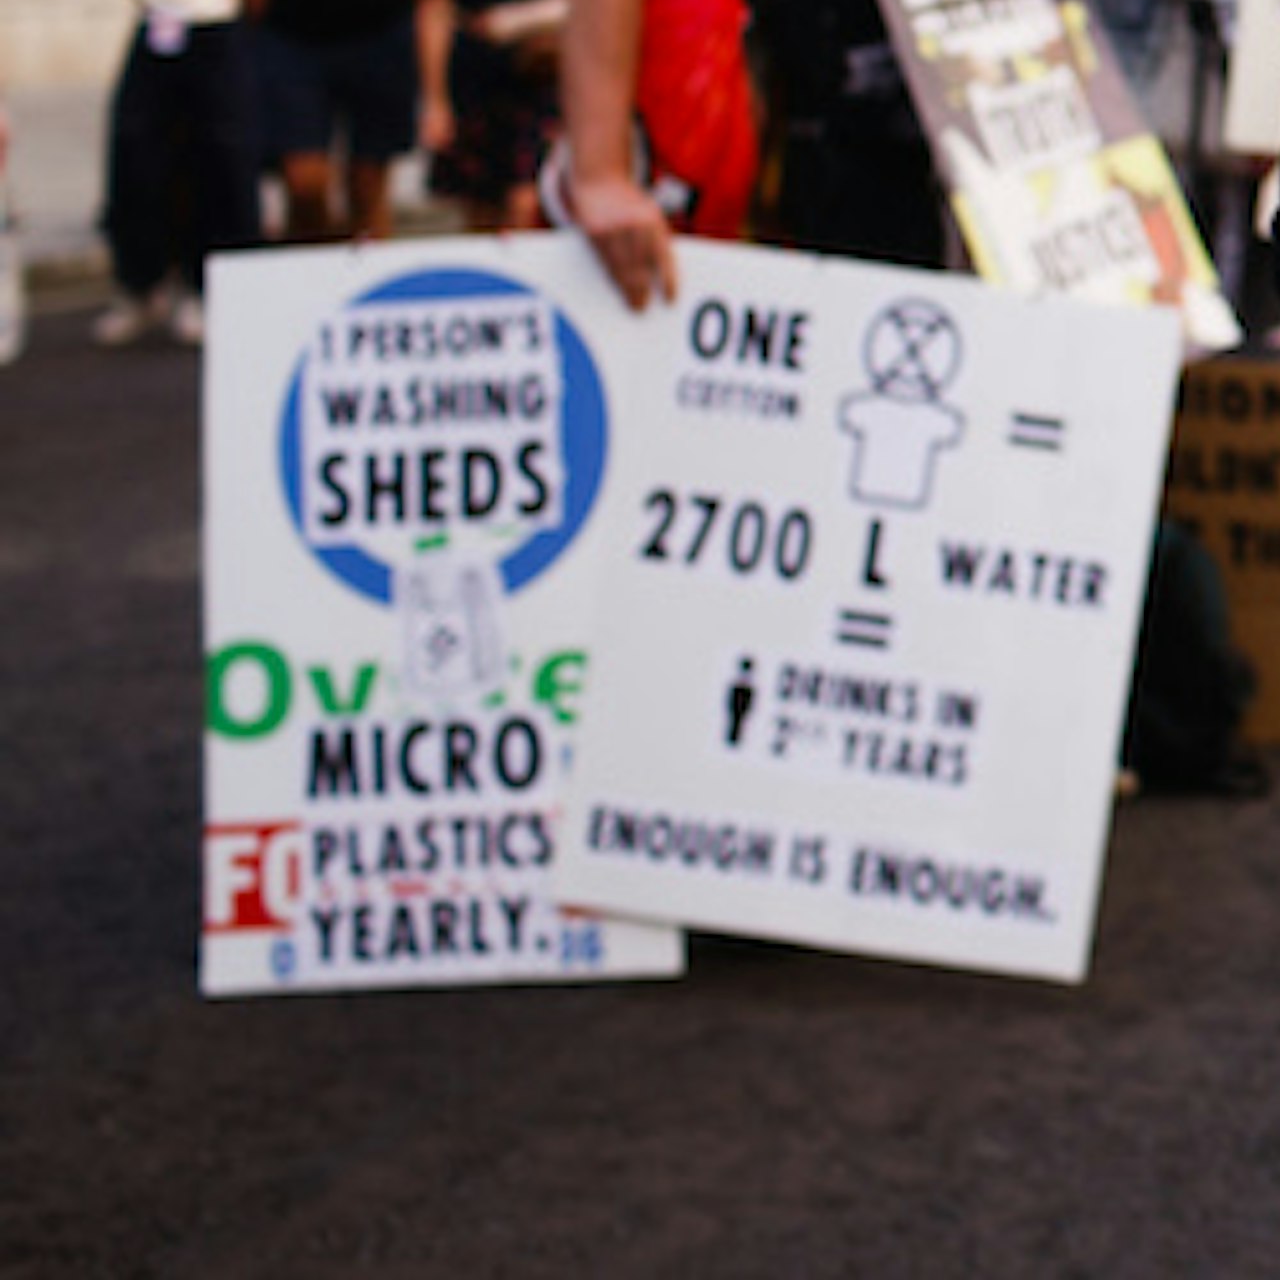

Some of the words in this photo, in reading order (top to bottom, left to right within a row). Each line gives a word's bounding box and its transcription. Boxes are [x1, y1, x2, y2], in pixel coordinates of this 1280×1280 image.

[347, 312, 543, 362] PERSON'S
[688, 298, 811, 373] ONE
[320, 374, 551, 430] WASHING
[318, 439, 551, 529] SHEDS
[640, 488, 814, 583] 2700
[861, 517, 890, 591] L
[940, 540, 1110, 609] WATER
[775, 661, 920, 726] DRINKS
[936, 691, 980, 731] IN
[305, 715, 545, 800] MICRO
[842, 728, 976, 787] YEARS
[312, 811, 556, 879] PLASTICS
[586, 803, 775, 873] ENOUGH
[789, 835, 829, 886] IS
[848, 846, 1056, 922] ENOUGH.
[309, 895, 551, 964] YEARLY.
